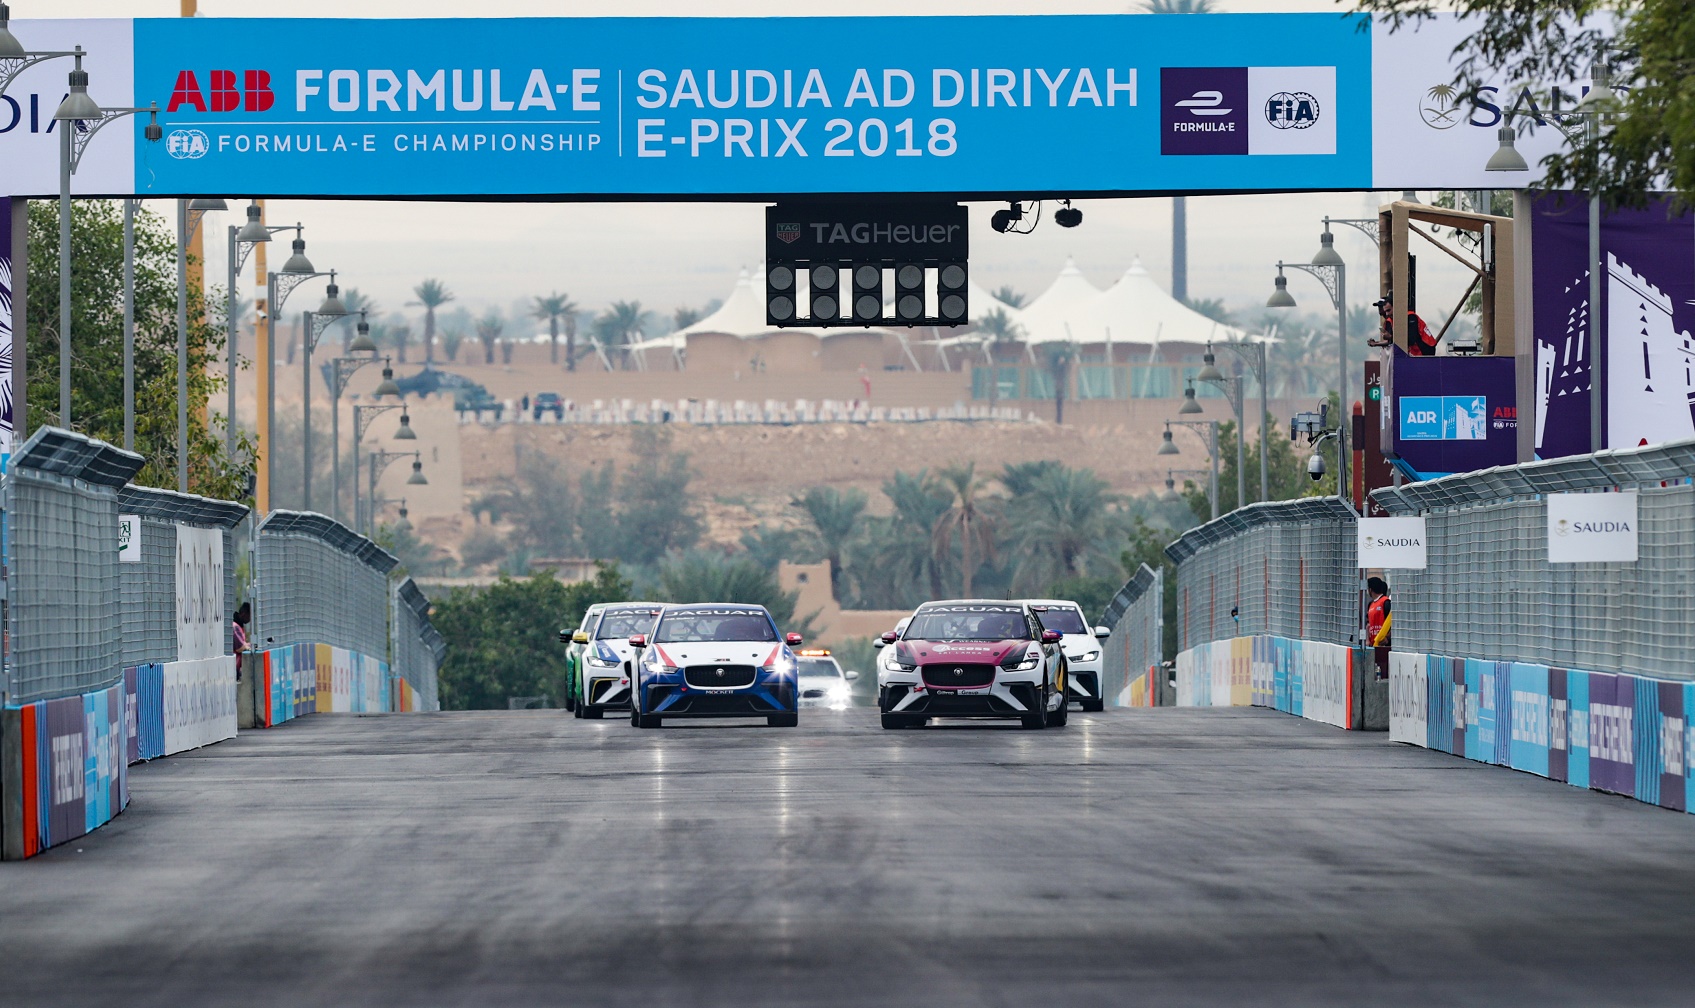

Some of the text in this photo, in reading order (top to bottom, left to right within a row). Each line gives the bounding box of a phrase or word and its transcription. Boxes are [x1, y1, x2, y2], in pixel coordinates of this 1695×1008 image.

[166, 69, 600, 112] ABB FORMULA-E
[636, 68, 1138, 108] SAUDIA AD DIRIYAH
[218, 135, 376, 152] FORMULA-E
[394, 134, 601, 152] CHAMPIONSHIP
[637, 118, 958, 157] E-PRIX 2018
[778, 232, 799, 242] HEUER
[1406, 411, 1437, 424] ADR
[1572, 521, 1631, 533] SAUDIA
[1377, 538, 1421, 547] SAUDIA
[665, 609, 764, 617] JAGUAR
